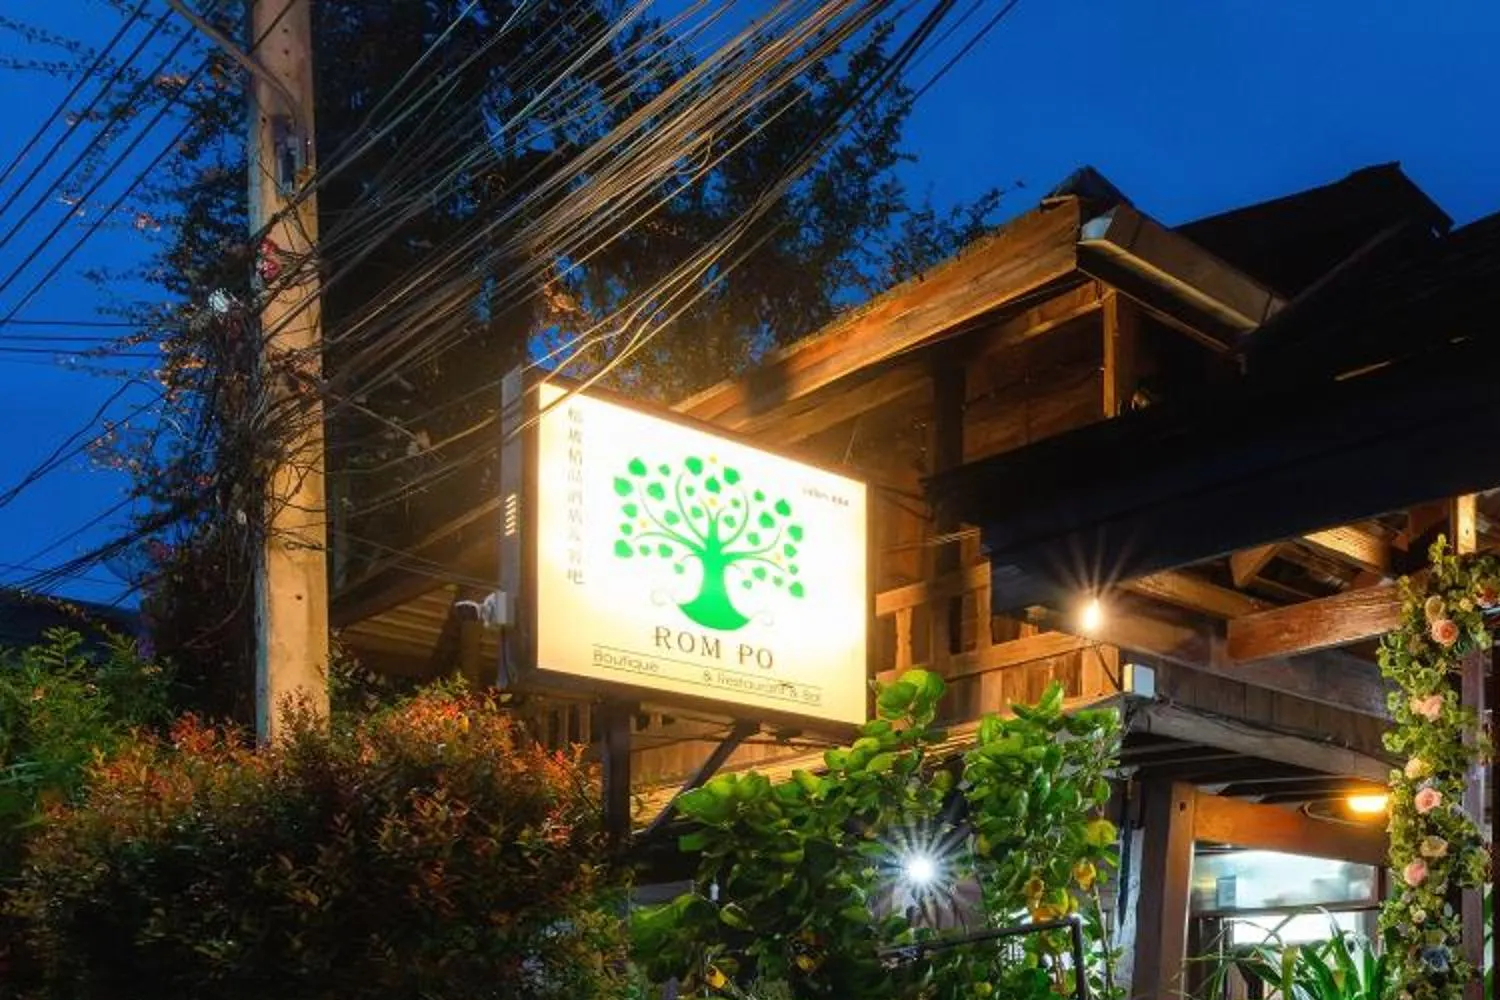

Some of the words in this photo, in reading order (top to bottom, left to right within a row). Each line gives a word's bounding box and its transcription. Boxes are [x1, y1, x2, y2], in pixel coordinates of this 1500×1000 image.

[654, 625, 721, 659] ROM
[738, 643, 774, 670] PO
[593, 649, 660, 673] Boutique
[703, 670, 712, 682] &
[717, 671, 785, 694] Restaurant
